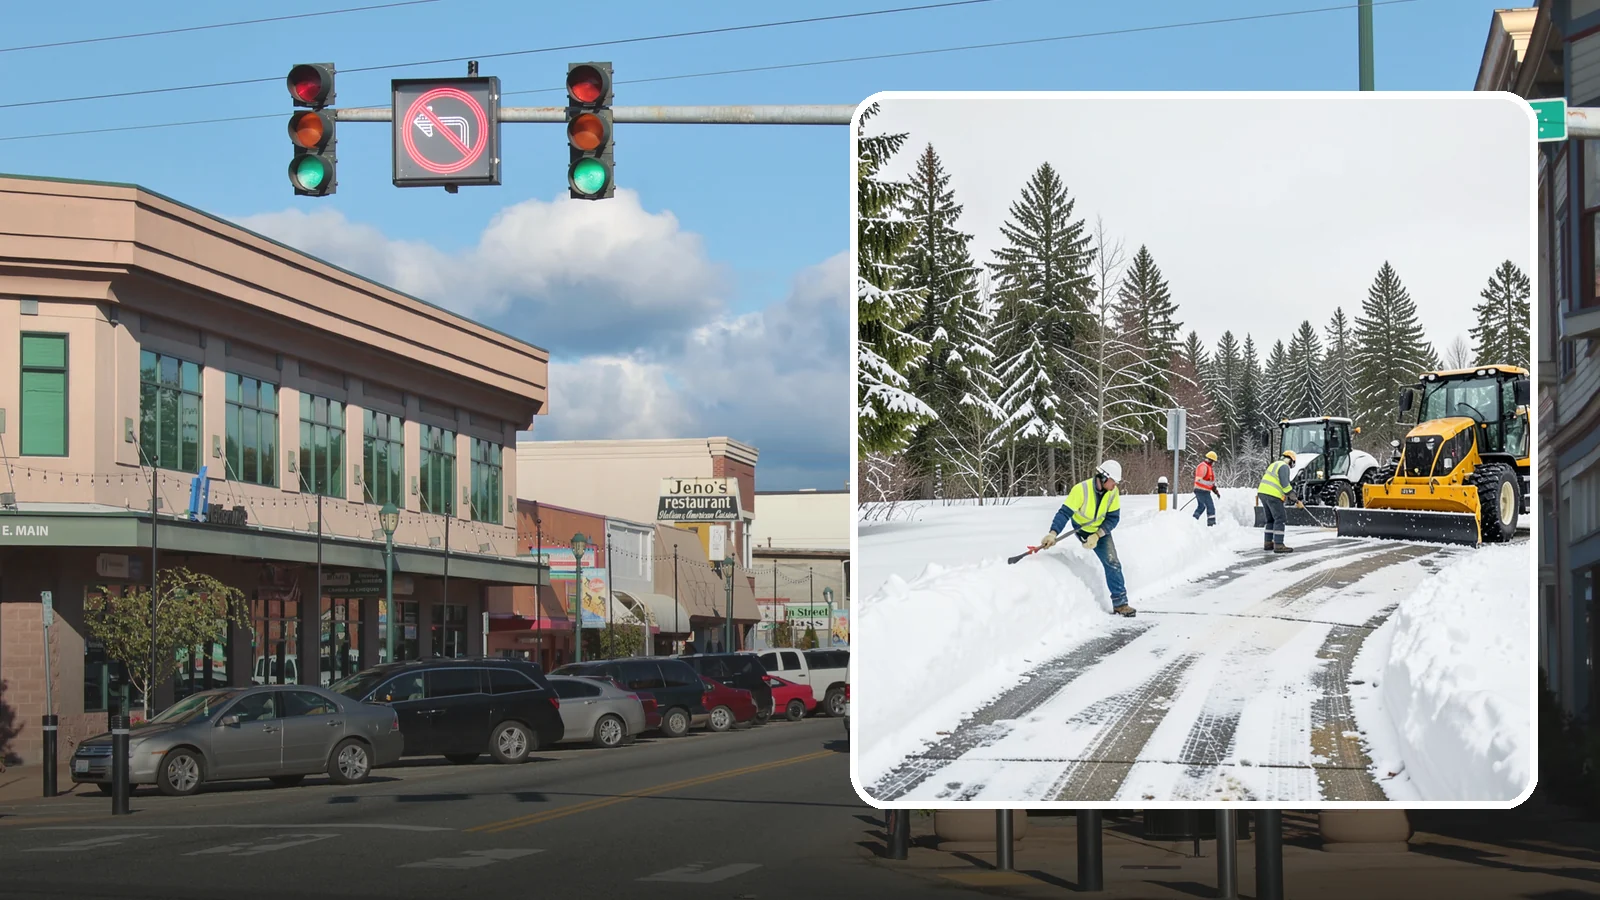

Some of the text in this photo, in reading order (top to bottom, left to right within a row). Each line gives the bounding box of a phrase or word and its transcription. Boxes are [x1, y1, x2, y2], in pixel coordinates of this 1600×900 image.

[670, 480, 727, 494] Jeno's
[665, 497, 731, 509] restaurant
[659, 510, 681, 519] Italian
[686, 509, 714, 519] American
[715, 509, 737, 519] Cuisine
[2, 525, 49, 536] E. MAIN
[797, 607, 829, 617] Street
